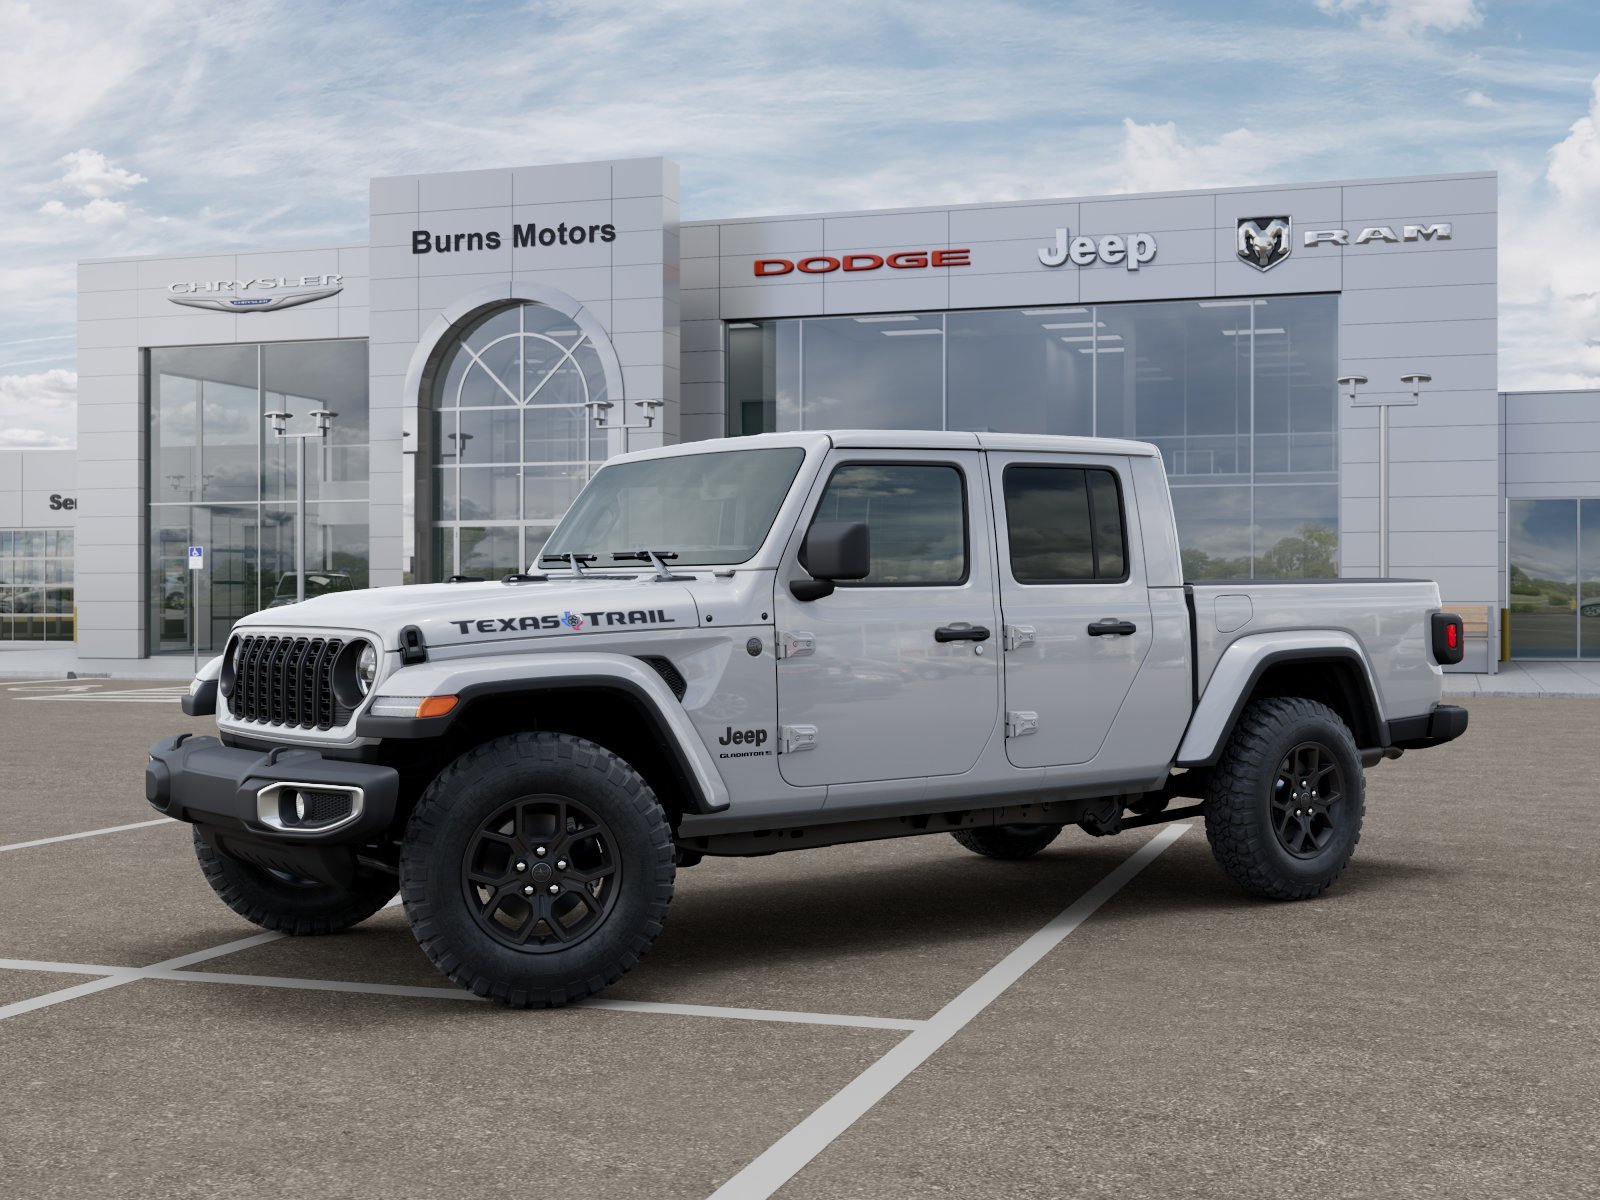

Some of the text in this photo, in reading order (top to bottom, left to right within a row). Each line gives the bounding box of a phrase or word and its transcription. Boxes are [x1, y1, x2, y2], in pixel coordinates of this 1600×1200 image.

[412, 222, 616, 254] Burns Motors
[1304, 222, 1452, 248] RAM
[1037, 227, 1157, 271] Jeep
[754, 249, 971, 277] DODGE
[167, 273, 343, 294] CHRYSLER
[449, 609, 675, 635] TEXAS TRAIL
[718, 726, 768, 747] Jeep
[719, 751, 765, 759] GLADIATOR
